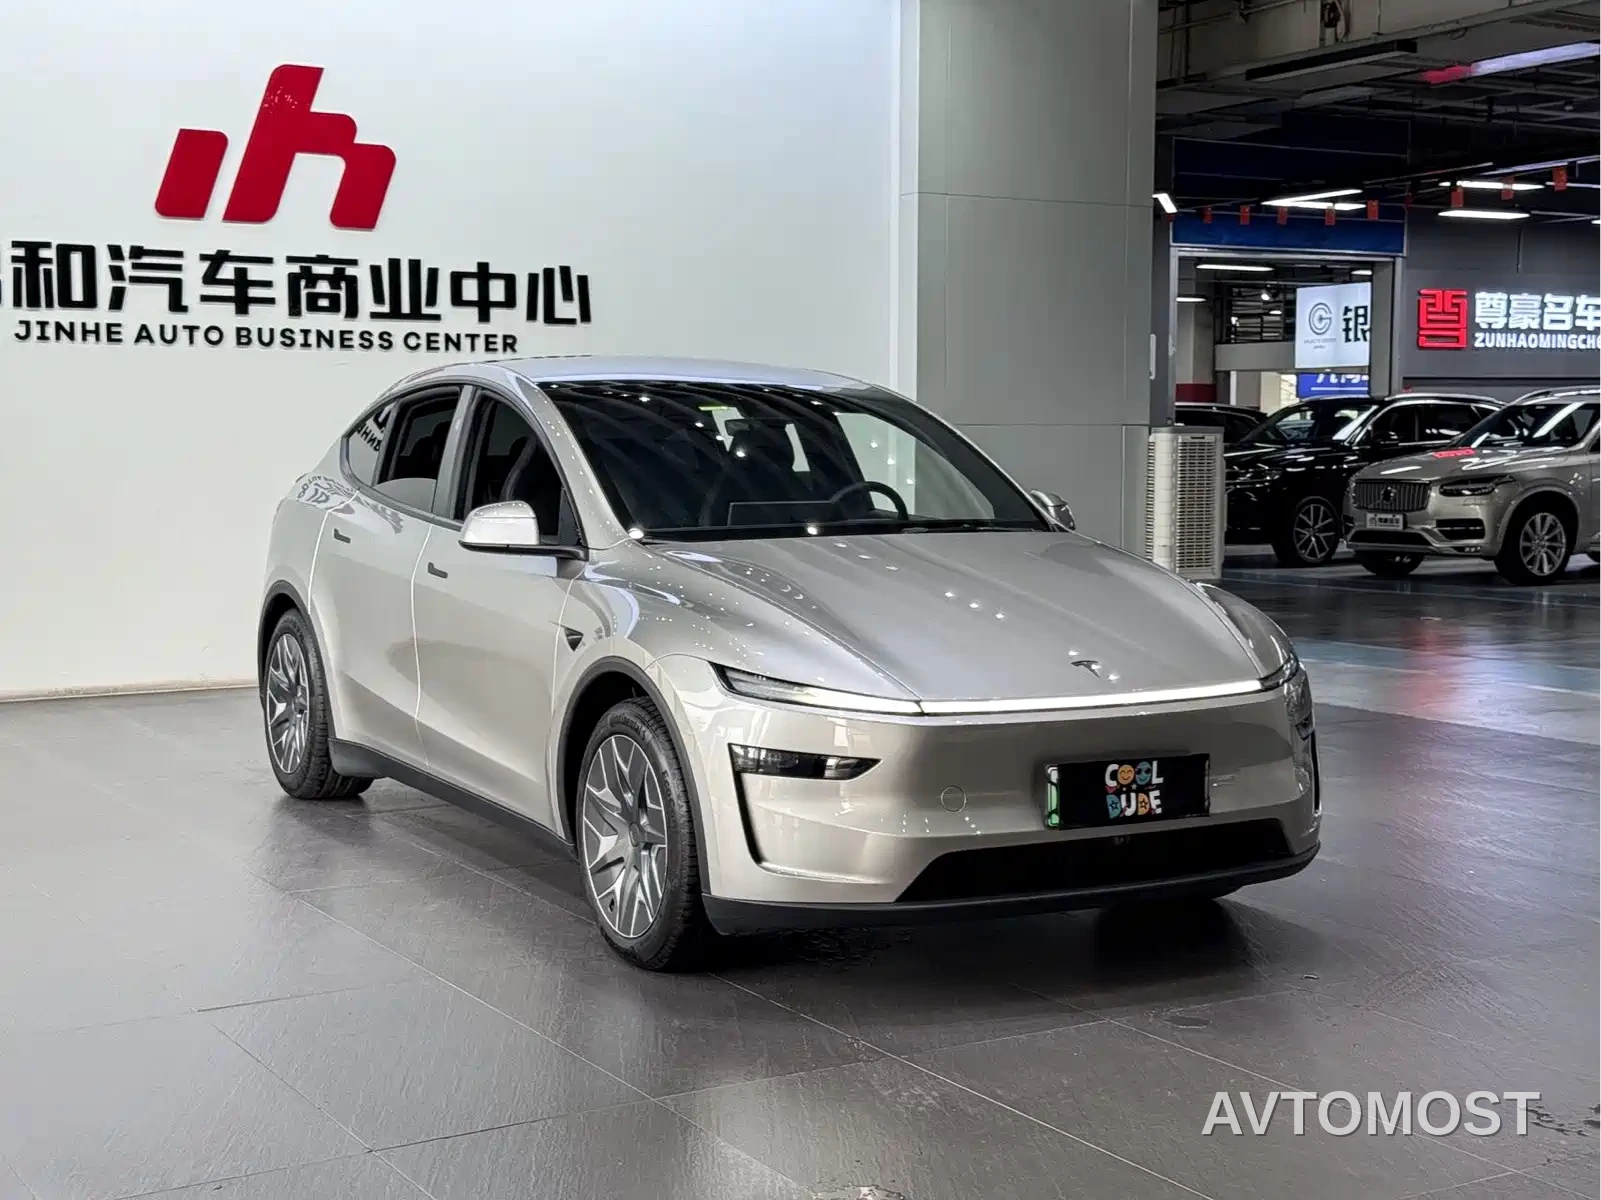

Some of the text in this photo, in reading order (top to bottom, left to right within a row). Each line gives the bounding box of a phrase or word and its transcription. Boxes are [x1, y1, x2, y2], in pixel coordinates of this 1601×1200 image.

[0, 240, 592, 325] 和汽车商业中心
[1474, 291, 1600, 331] 尊豪名车
[14, 319, 518, 353] JINHE AUTO BUSINESS CENTER
[1105, 760, 1164, 787] COOL
[1106, 790, 1163, 819] DUDE
